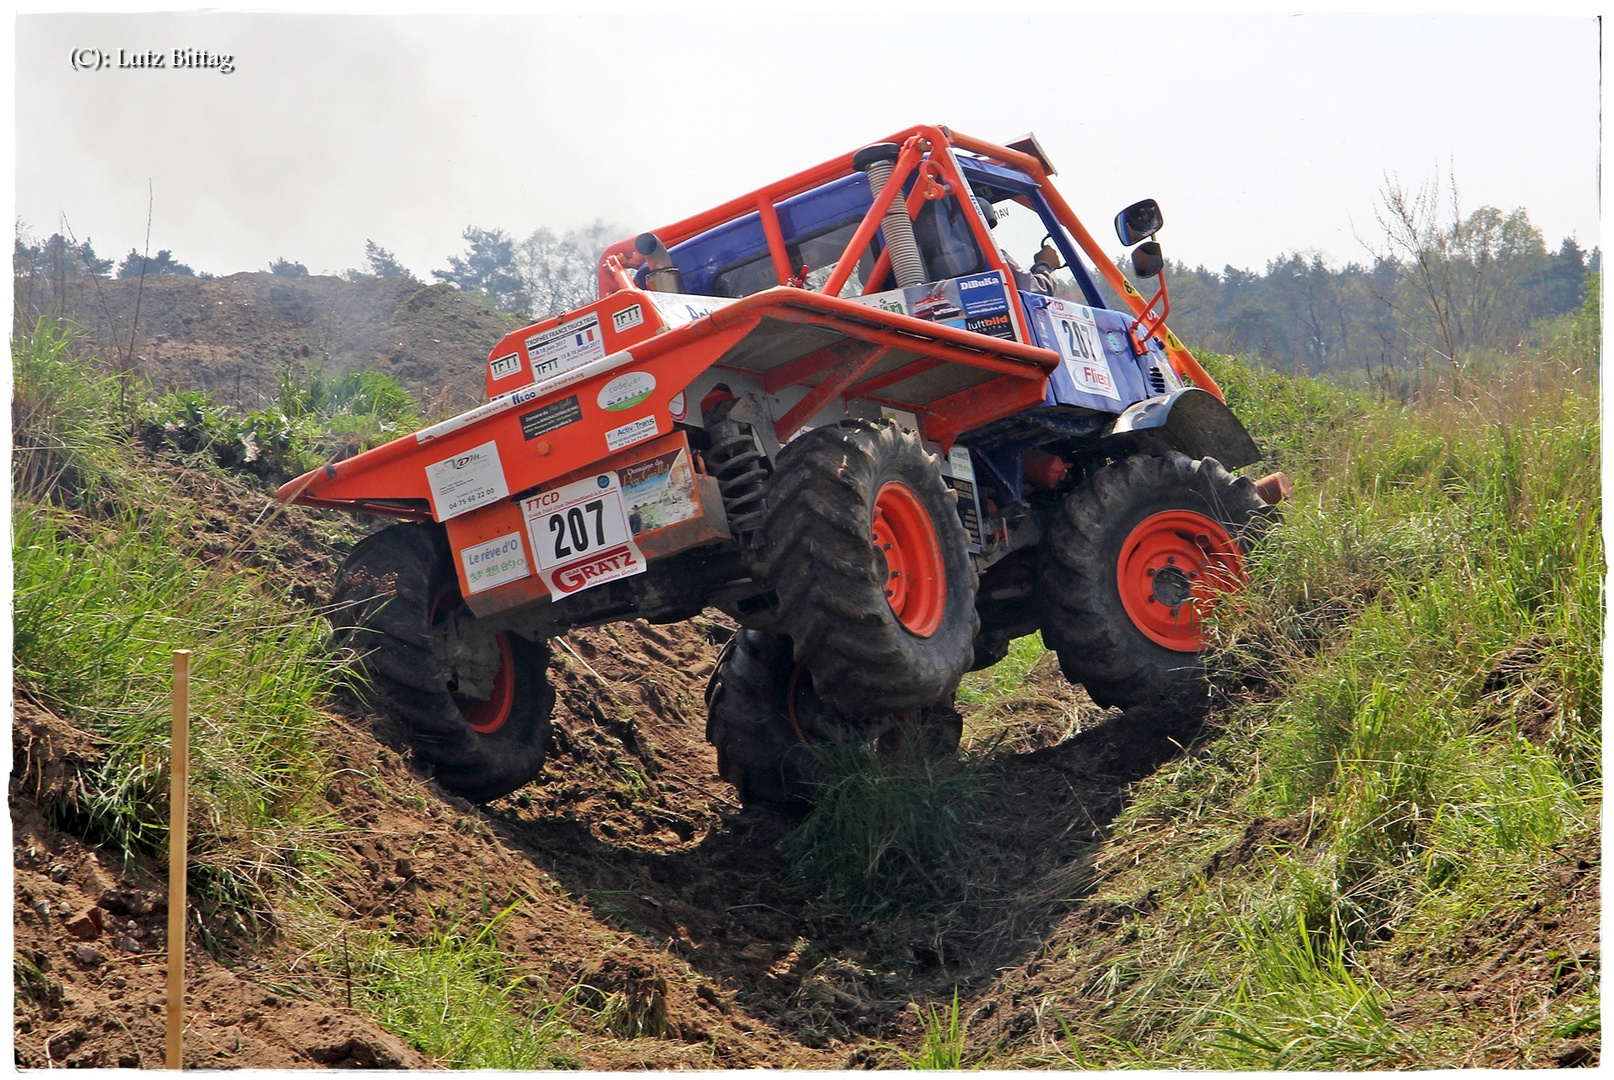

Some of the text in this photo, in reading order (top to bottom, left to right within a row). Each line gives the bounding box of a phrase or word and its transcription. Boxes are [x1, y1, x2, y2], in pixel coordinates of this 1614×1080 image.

[960, 277, 1000, 291] DiBuKa
[526, 332, 549, 346] TROPHÉE
[549, 326, 567, 339] FRANCE
[567, 320, 583, 331] TRUCK
[583, 315, 597, 324] TRIAL
[967, 314, 1009, 331] luftbild
[556, 340, 567, 348] 2017
[1061, 319, 1097, 361] 207
[617, 425, 634, 436] Activ
[634, 418, 655, 430] Trans
[626, 461, 654, 476] Domaine
[449, 501, 458, 510] 04
[458, 498, 467, 506] 75
[477, 491, 485, 499] 22
[486, 487, 495, 496] 00
[526, 491, 560, 512] TTCD
[549, 499, 605, 560] 207
[469, 538, 518, 565] Le rêve d'O
